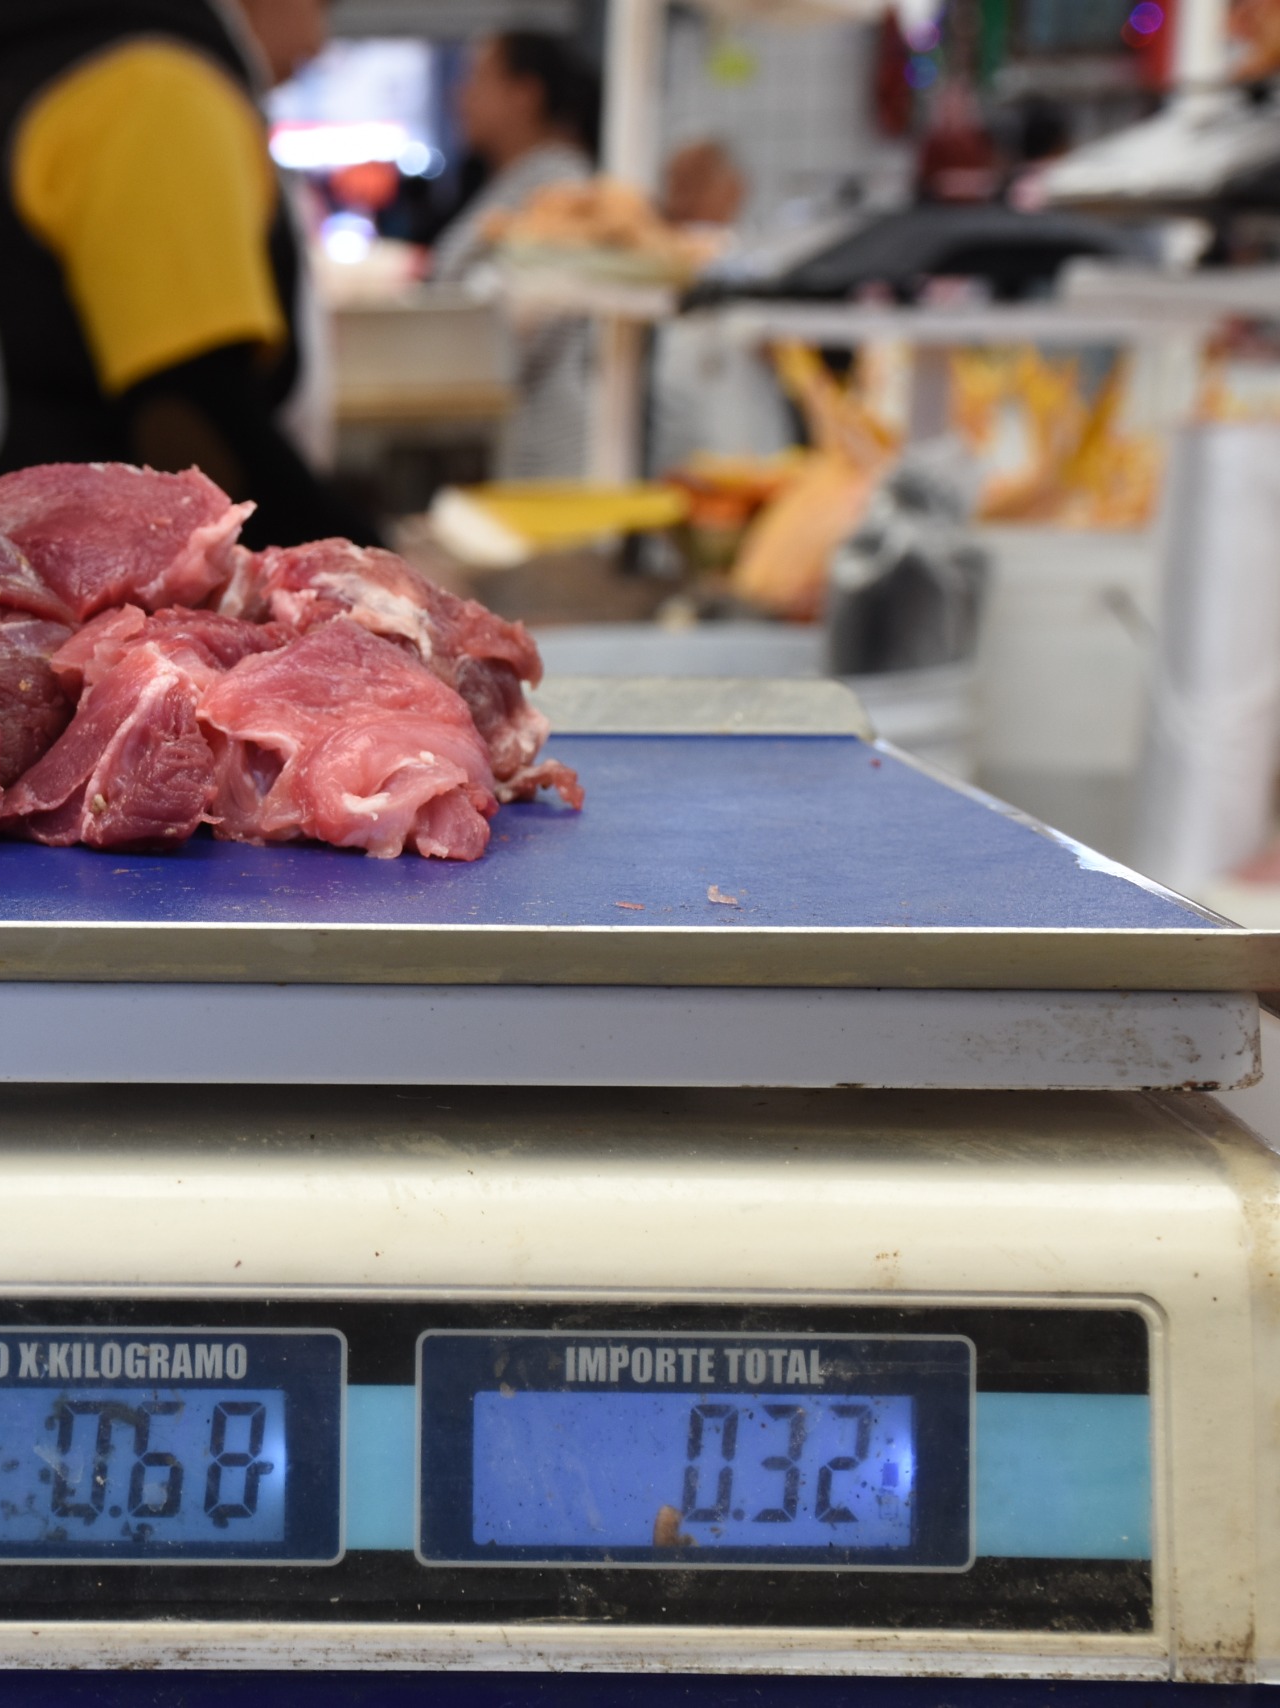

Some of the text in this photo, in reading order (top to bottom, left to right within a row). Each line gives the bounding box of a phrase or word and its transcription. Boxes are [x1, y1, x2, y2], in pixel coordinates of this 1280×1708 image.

[18, 1342, 39, 1378] X
[48, 1342, 248, 1380] KILOGRAMO
[566, 1347, 825, 1385] IMPORTE TOTAL
[51, 1401, 266, 1518] 0.68
[682, 1404, 872, 1523] 0.32
